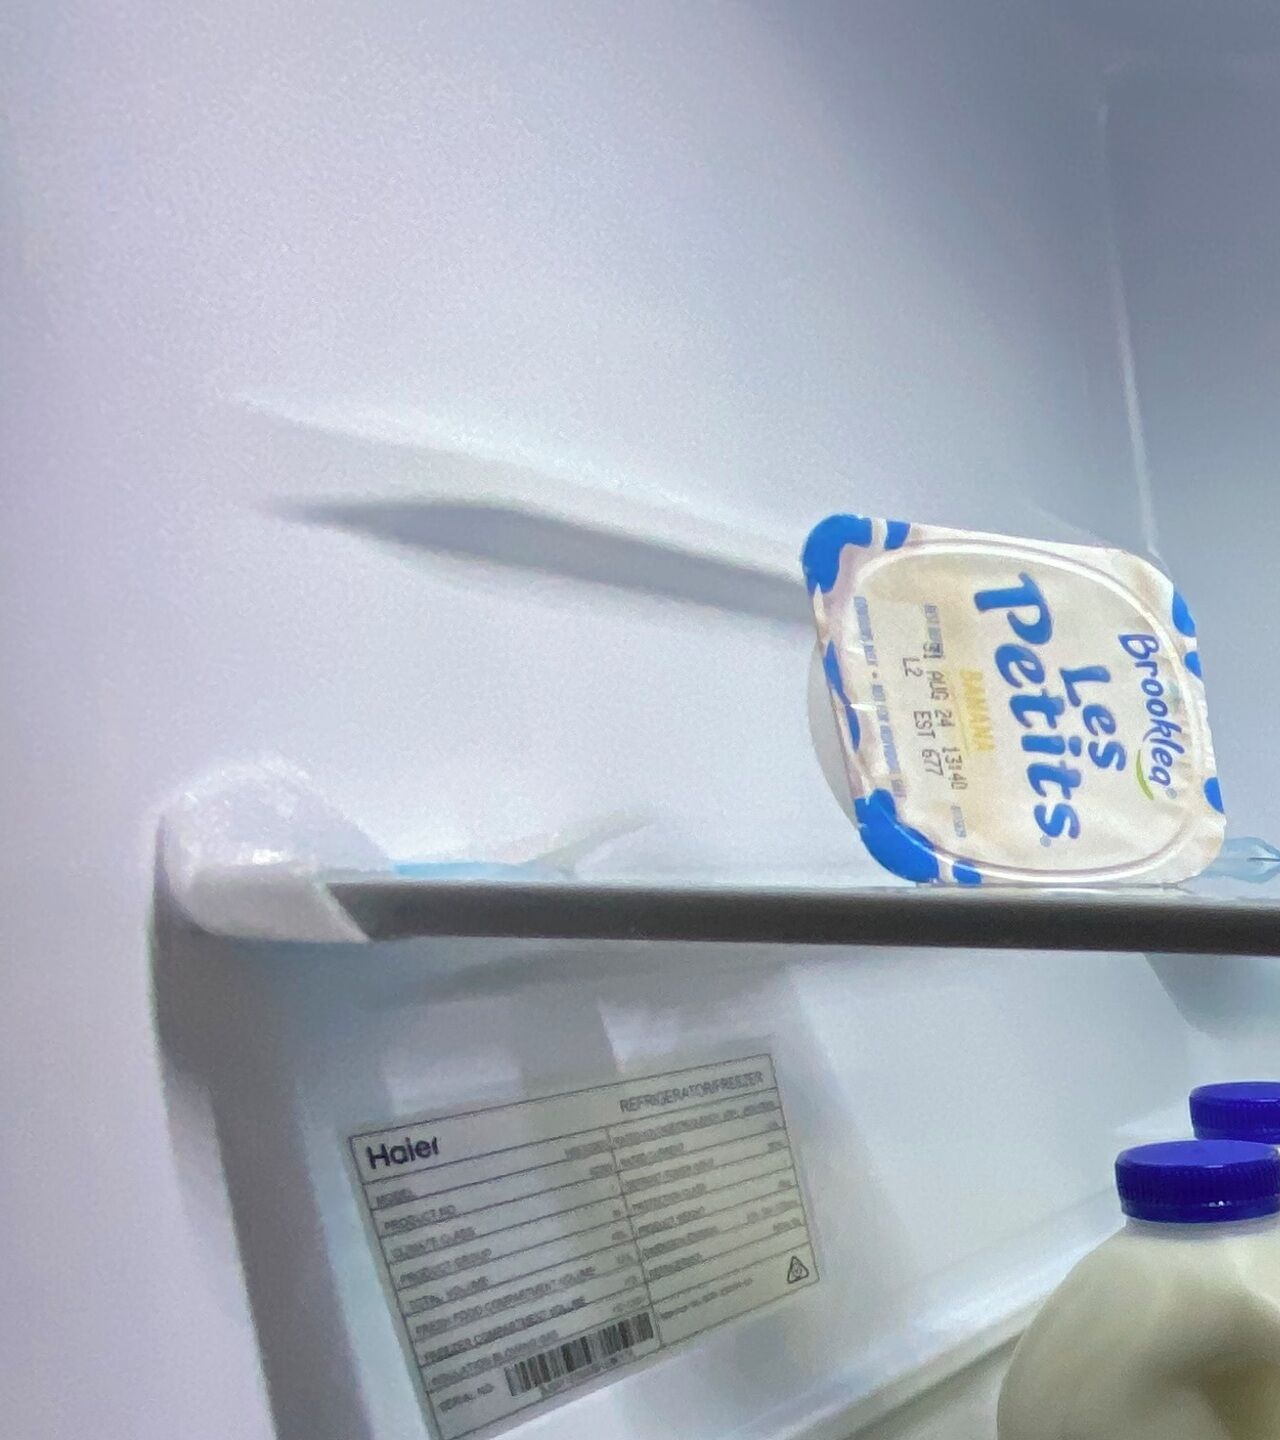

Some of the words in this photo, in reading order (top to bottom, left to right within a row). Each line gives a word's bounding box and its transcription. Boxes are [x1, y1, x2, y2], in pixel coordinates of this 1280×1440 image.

[903, 657, 924, 678] L2
[928, 670, 949, 701] AUG
[934, 711, 952, 727] 24
[974, 571, 1082, 840] Petits
[1062, 665, 1127, 771] Les
[1118, 633, 1185, 787] Brooklea
[913, 711, 935, 739] EST
[922, 751, 943, 777] 677
[367, 1136, 441, 1170] Haier
